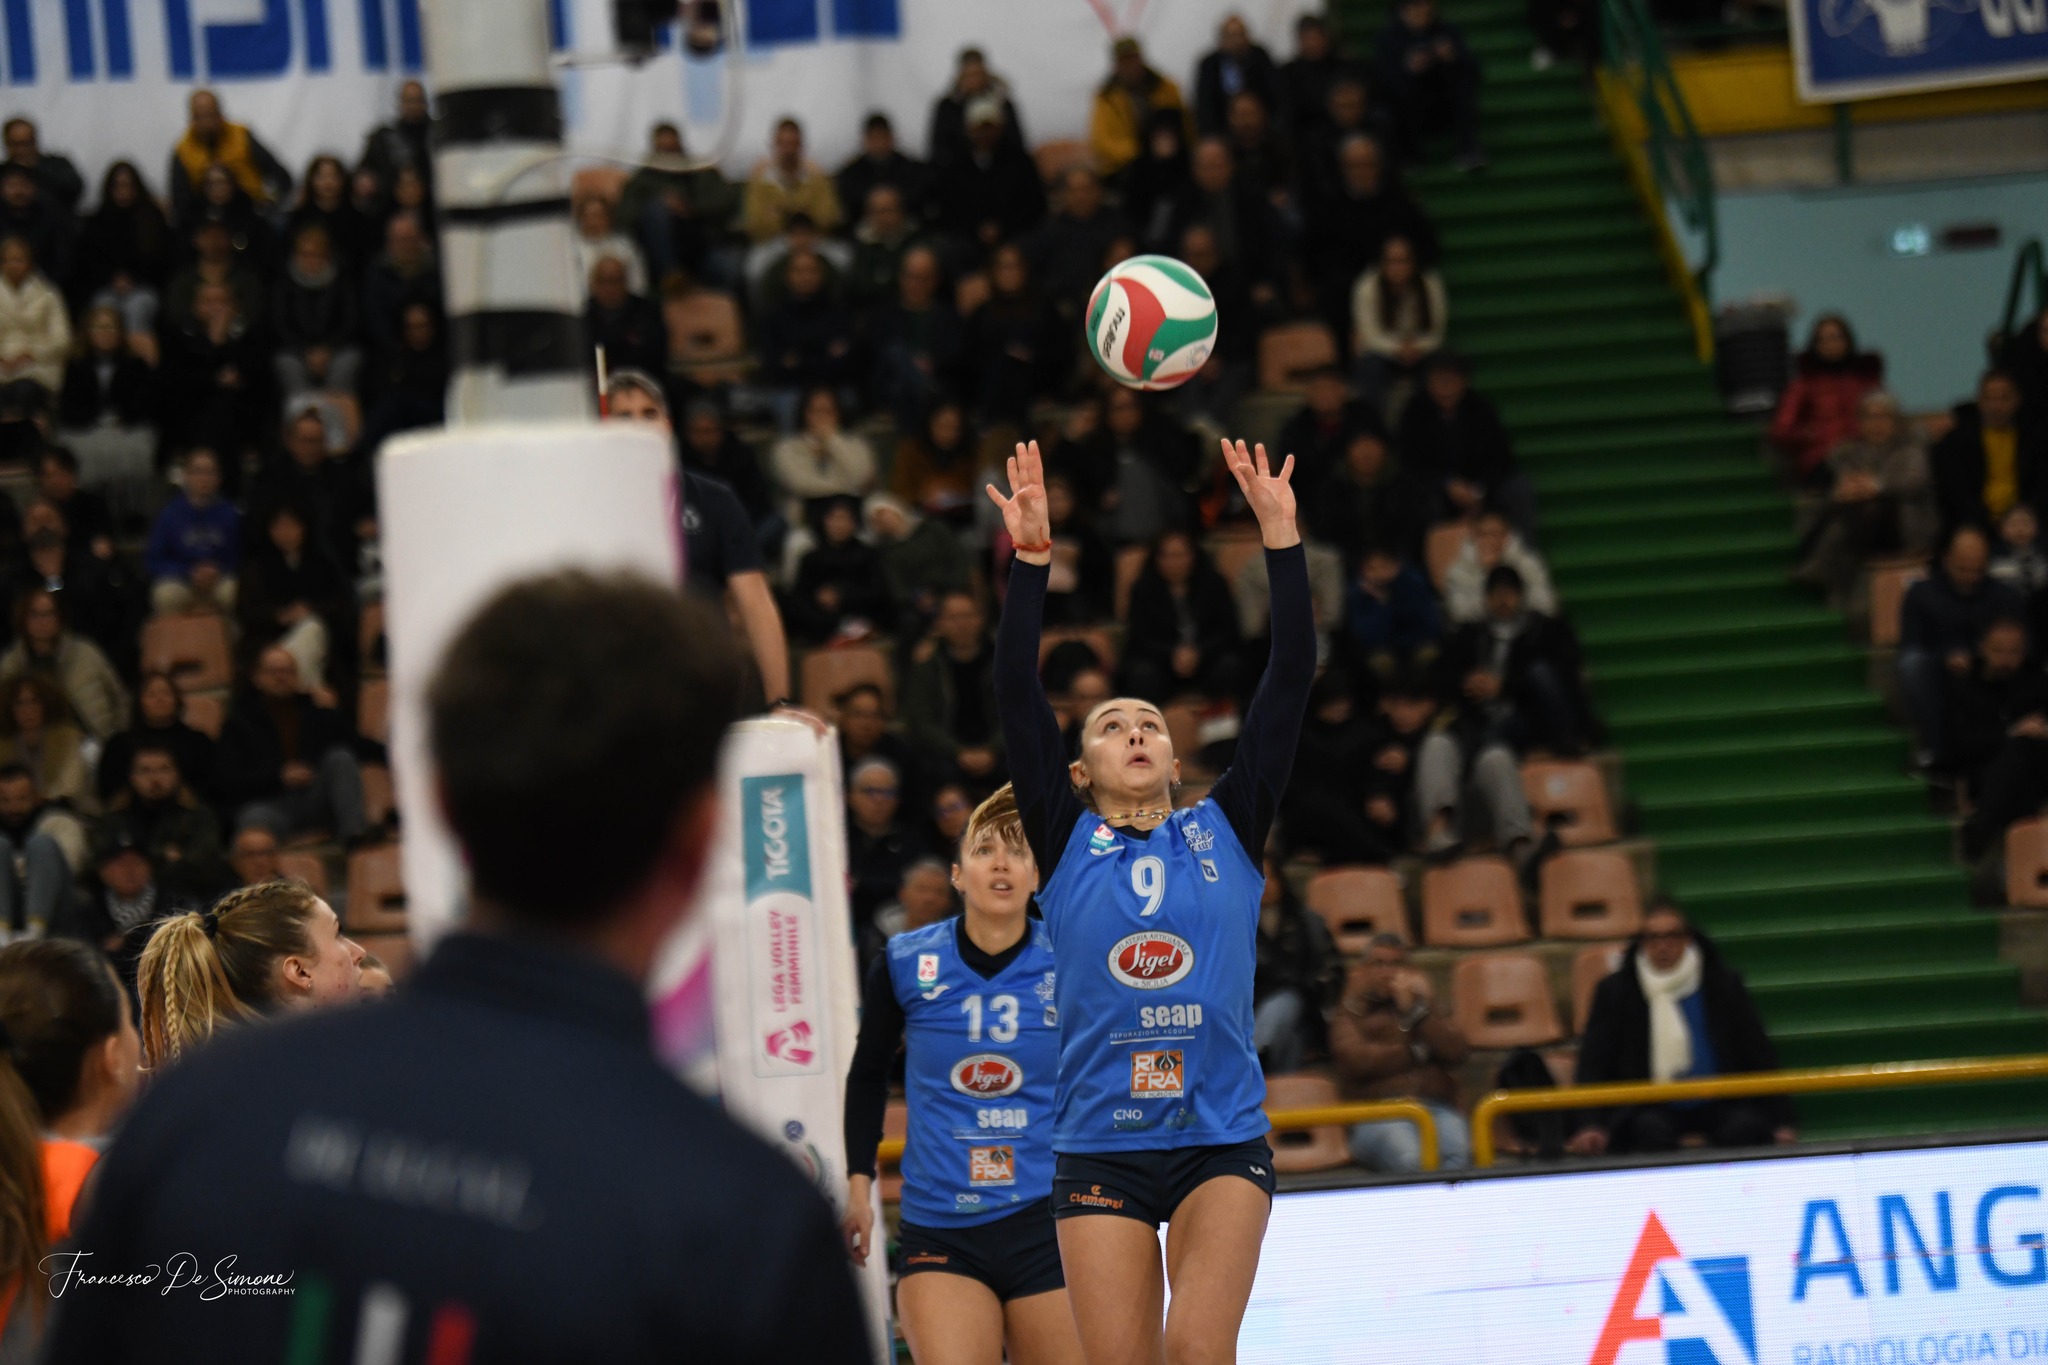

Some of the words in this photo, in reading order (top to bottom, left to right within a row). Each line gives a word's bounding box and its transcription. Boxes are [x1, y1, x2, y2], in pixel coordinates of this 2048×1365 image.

[1131, 855, 1166, 917] 9
[769, 910, 785, 968] VOLLEY
[786, 915, 802, 1005] FEMMINILE
[1123, 941, 1178, 976] Sigel
[772, 975, 786, 1012] LEGA
[961, 994, 1020, 1044] 13
[1140, 1003, 1203, 1029] seap
[1109, 1029, 1160, 1039] DEPURAZIONE
[965, 1063, 1010, 1091] Sigel
[1134, 1071, 1181, 1090] FRA
[977, 1109, 1028, 1129] seap
[1113, 1109, 1143, 1120] CNO
[972, 1164, 1012, 1179] FRA
[1792, 1184, 2048, 1303] ANG
[1793, 1332, 1996, 1365] RADIOLOGIA
